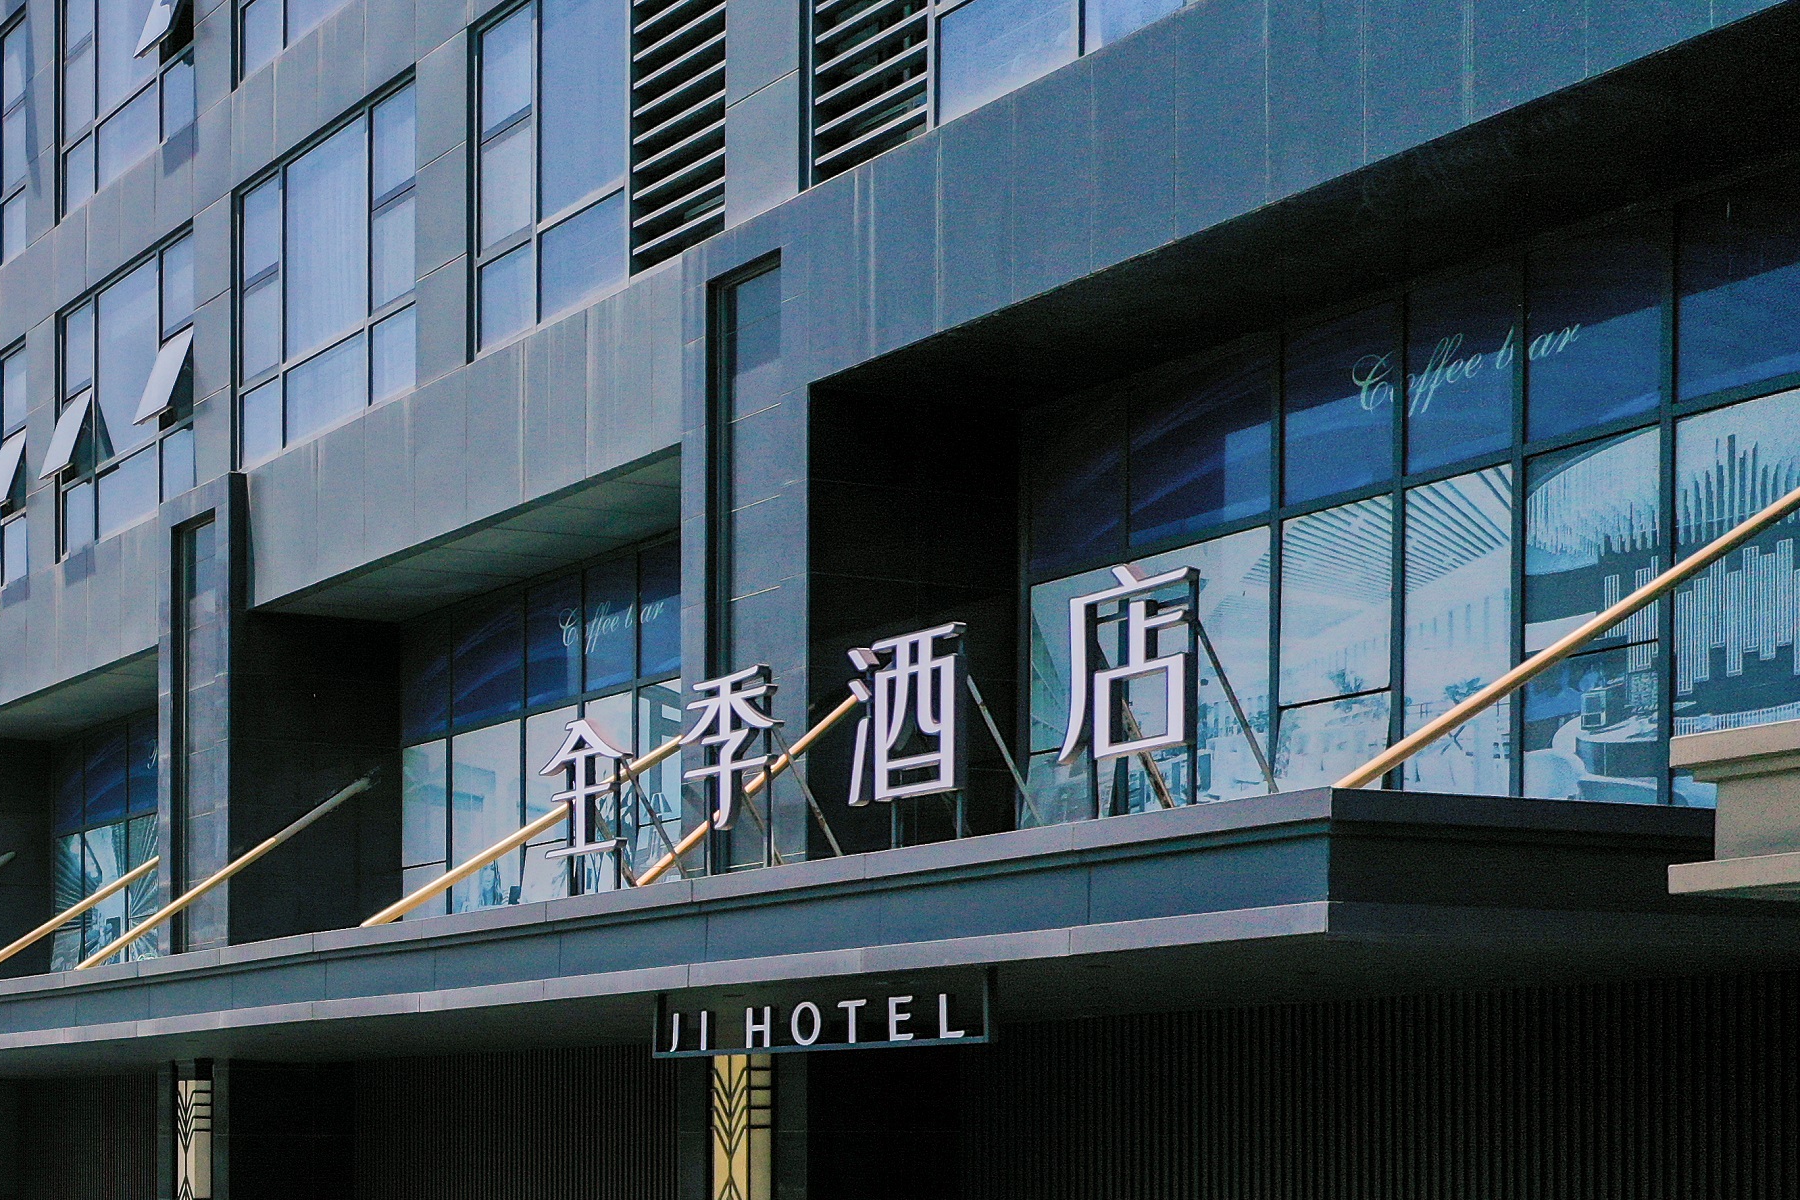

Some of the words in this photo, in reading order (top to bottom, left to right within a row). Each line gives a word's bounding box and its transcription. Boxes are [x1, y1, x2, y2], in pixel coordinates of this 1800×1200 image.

[1352, 332, 1485, 417] Coffee
[1496, 316, 1581, 370] bar
[558, 600, 620, 655] Coffee
[624, 600, 665, 630] bar
[538, 564, 1201, 860] 全季酒店
[670, 1010, 708, 1053] JI
[745, 993, 965, 1048] HOTEL
